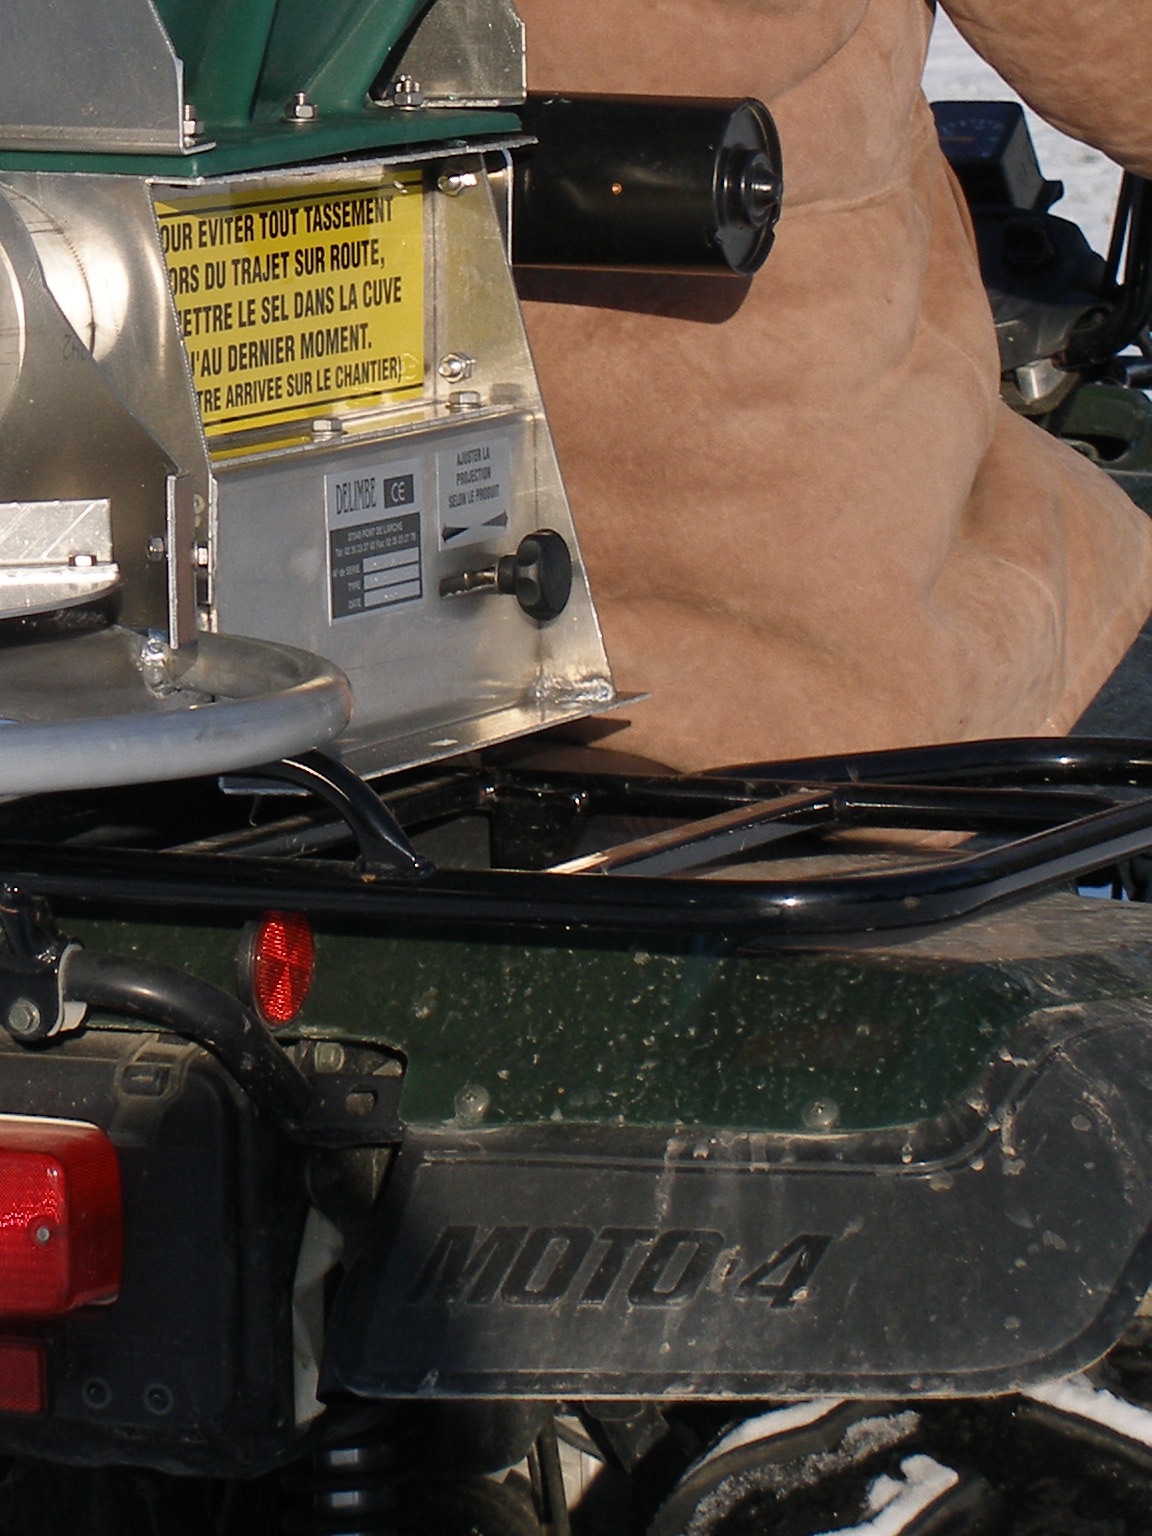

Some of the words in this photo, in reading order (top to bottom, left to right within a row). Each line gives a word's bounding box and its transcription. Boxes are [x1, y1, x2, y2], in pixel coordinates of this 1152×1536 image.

[198, 214, 254, 248] EVITER
[259, 208, 298, 240] TOUT
[304, 195, 394, 234] TASSEMENT
[205, 260, 226, 291] DU
[232, 251, 291, 287] TRAJET
[294, 245, 326, 276] SUR
[330, 238, 386, 270] ROUTE,
[178, 302, 233, 338] ETTRE
[239, 298, 256, 328] LE
[261, 291, 290, 325] SEL
[294, 285, 335, 319] DANS
[340, 282, 358, 312] LA
[363, 276, 403, 308] CUVE
[228, 334, 296, 373] DERNIER
[300, 322, 373, 361] MOMENT.
[226, 375, 283, 408] ARRIVEE
[286, 370, 313, 398] SUR
[316, 366, 332, 393] LE
[335, 354, 403, 389] CHANTIER)
[336, 477, 378, 515] DELIMBE
[456, 465, 492, 486] PROJECTION
